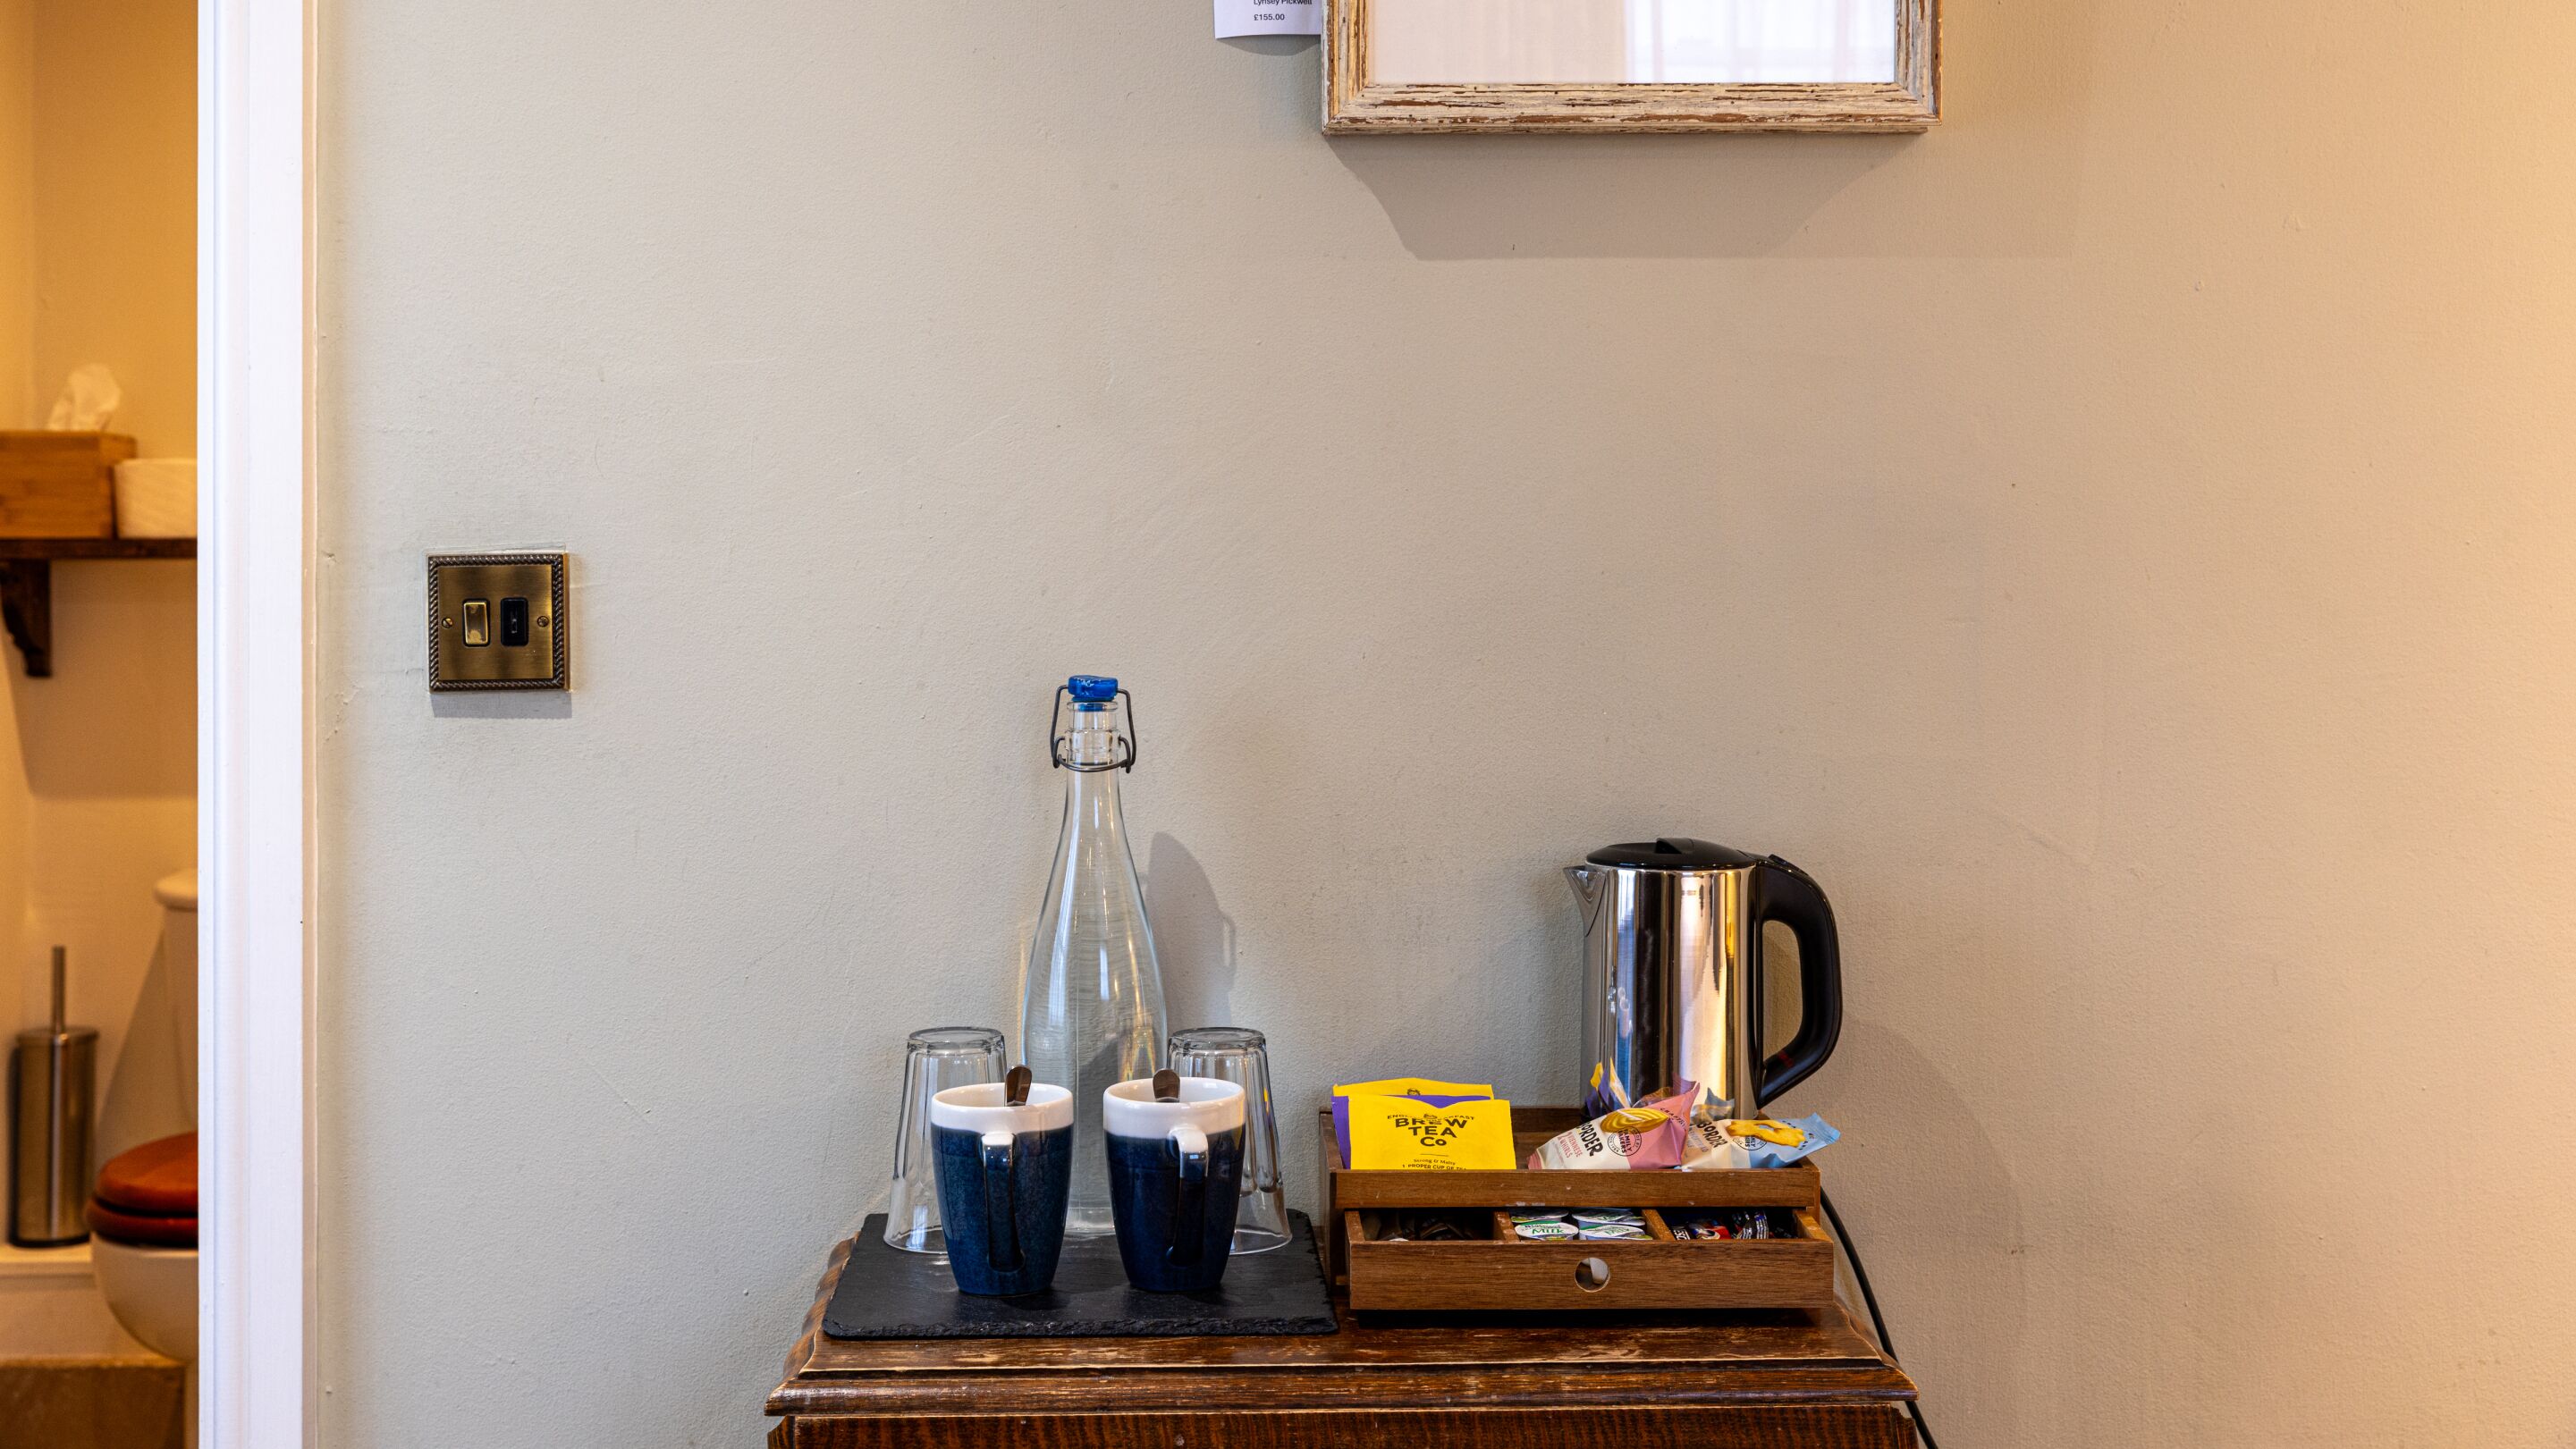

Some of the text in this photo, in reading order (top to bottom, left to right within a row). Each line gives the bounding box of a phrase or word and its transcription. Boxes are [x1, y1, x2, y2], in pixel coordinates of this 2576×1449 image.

[1395, 1117, 1467, 1128] BREW
[1407, 1125, 1457, 1138] TEA
[1624, 1129, 1633, 1151] FAMILY
[1697, 1120, 1728, 1149] BORDER
[1420, 1136, 1447, 1147] Co
[1618, 1130, 1626, 1153] BAKERS
